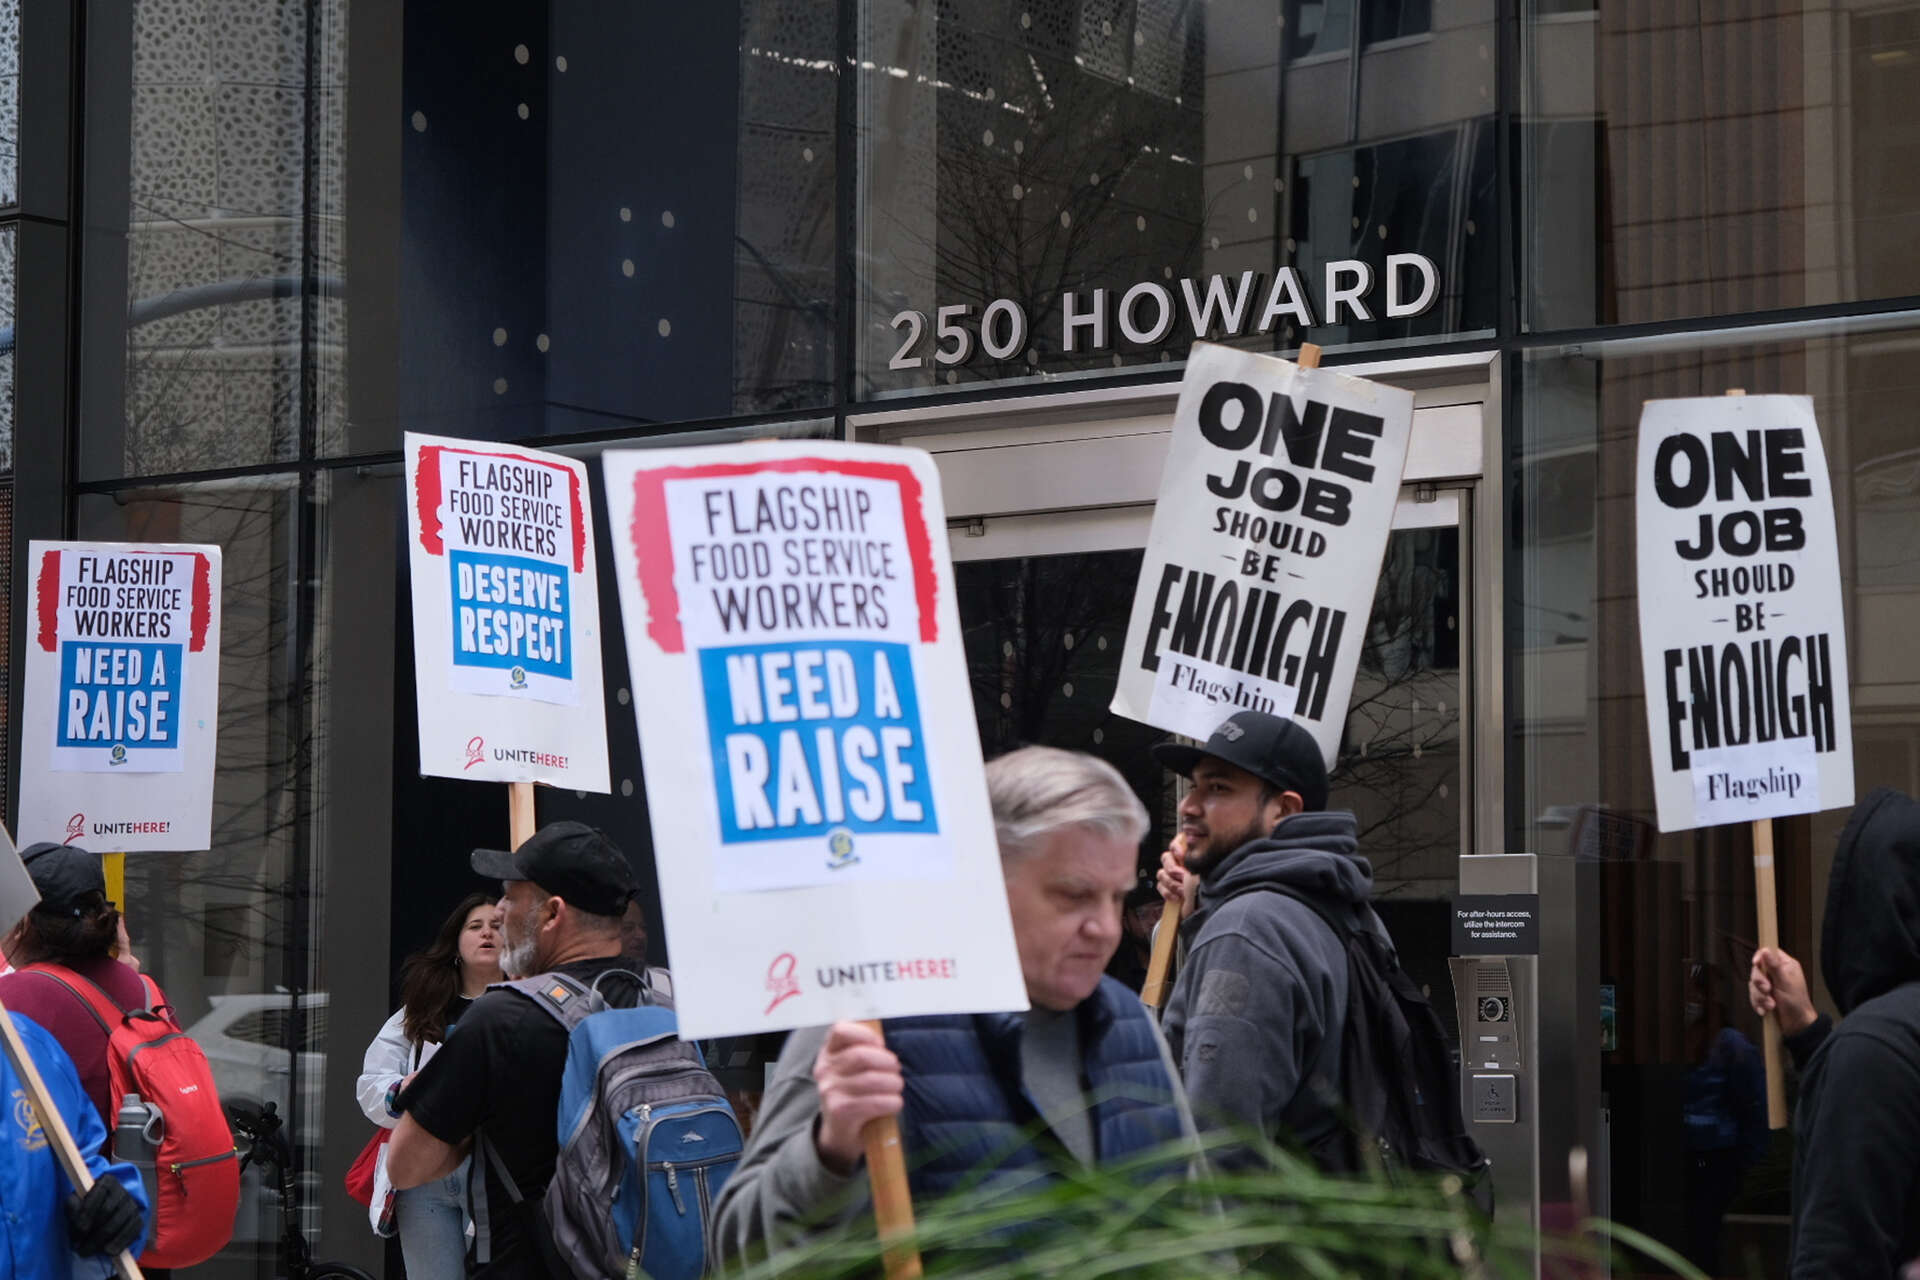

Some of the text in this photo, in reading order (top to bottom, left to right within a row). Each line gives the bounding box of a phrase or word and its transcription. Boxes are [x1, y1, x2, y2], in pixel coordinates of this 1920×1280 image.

[889, 253, 1440, 370] 250 HOWARD
[1198, 381, 1385, 484] ONE
[459, 460, 553, 499] FLAGSHIP
[1206, 459, 1352, 527] JOB
[1654, 428, 1813, 509] ONE
[450, 489, 563, 529] FOOD SERVICE
[704, 486, 872, 536] FLAGSHIP
[1213, 506, 1327, 558] SHOULD
[1675, 507, 1806, 561] JOB
[459, 516, 556, 557] WORKERS
[690, 539, 896, 582] FOOD SERVICE
[78, 557, 174, 586] FLAGSHIP
[458, 562, 562, 613] DESERVE
[1694, 563, 1795, 599] SHOULD
[67, 586, 182, 610] FOOD SERVICE
[712, 583, 889, 633] WORKERS
[74, 610, 171, 638] WORKERS
[460, 606, 563, 664] RESPECT
[1140, 563, 1347, 722] ENOUGH
[75, 647, 166, 686] NEED A
[725, 649, 902, 725] NEED A
[66, 689, 170, 741] RAISE
[1664, 633, 1836, 772] ENOUGH
[725, 724, 924, 830] RAISE
[1707, 766, 1801, 802] Flagship
[1457, 910, 1531, 919] For after-hours access,
